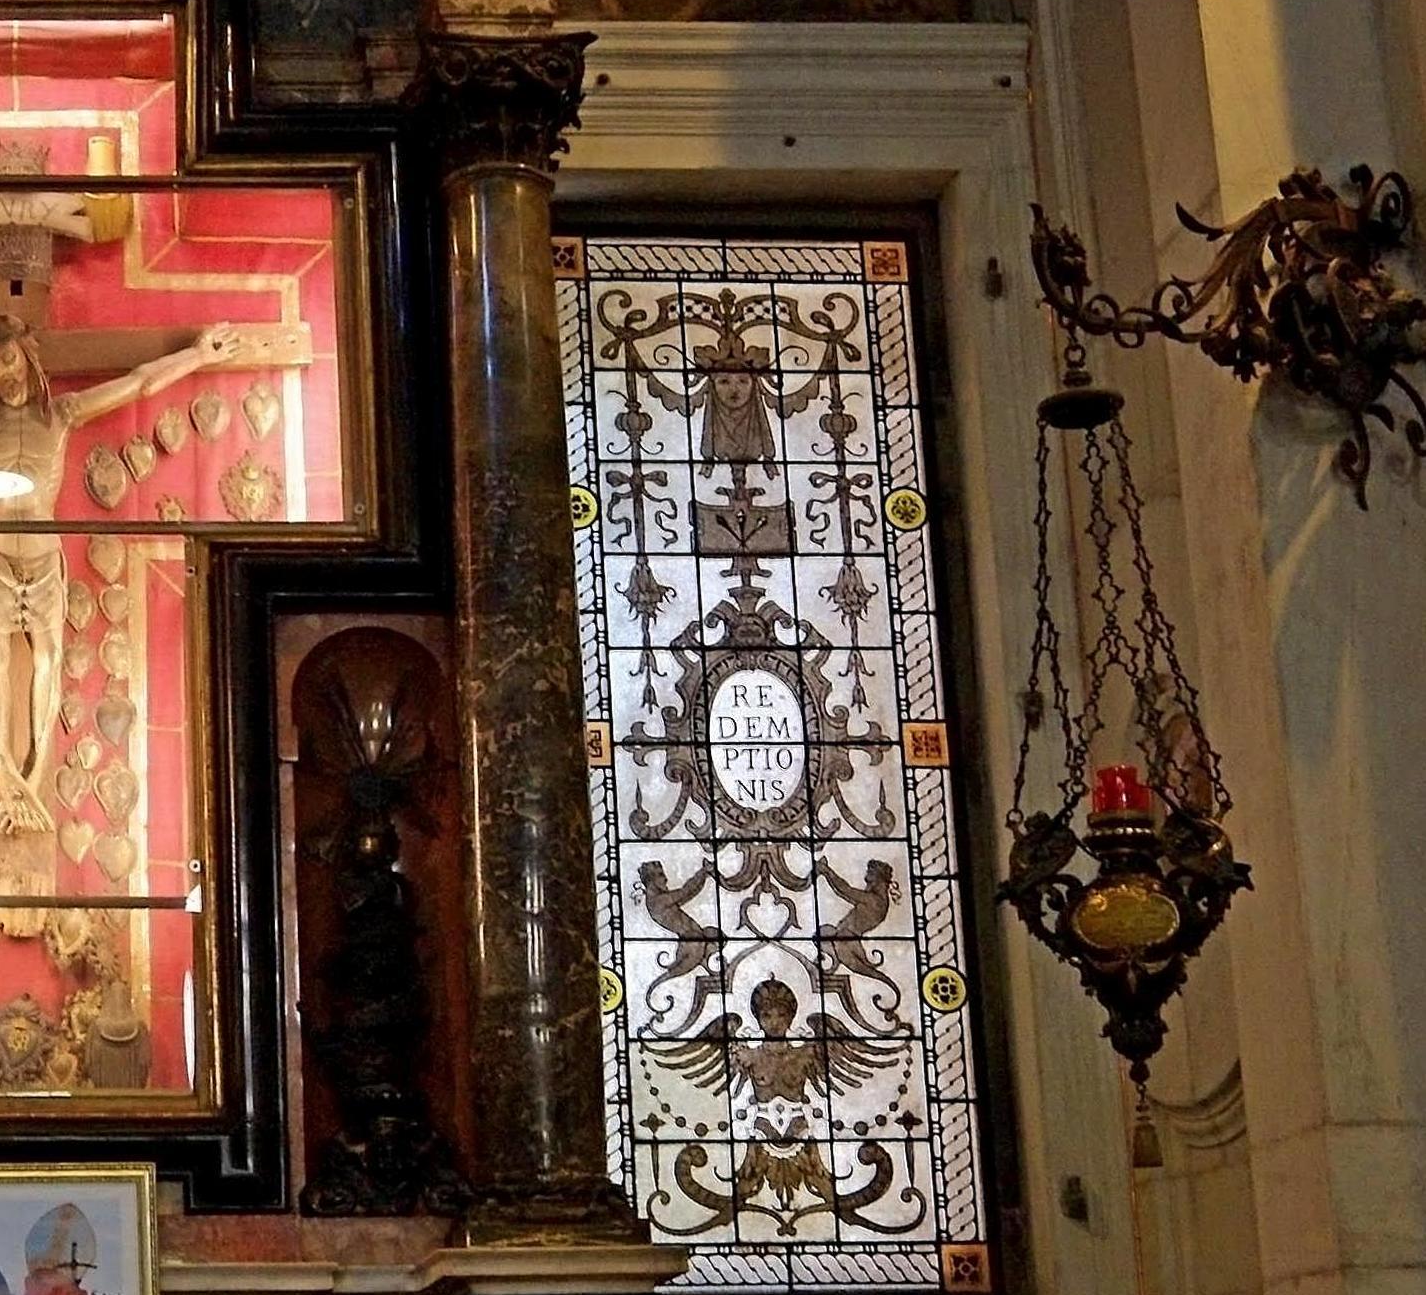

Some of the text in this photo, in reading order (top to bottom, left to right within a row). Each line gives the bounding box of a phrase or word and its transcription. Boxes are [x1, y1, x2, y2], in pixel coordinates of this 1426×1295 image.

[730, 685, 774, 708] RE
[717, 716, 791, 739] DEM
[722, 747, 793, 770] PTIO
[735, 779, 786, 802] NIS
